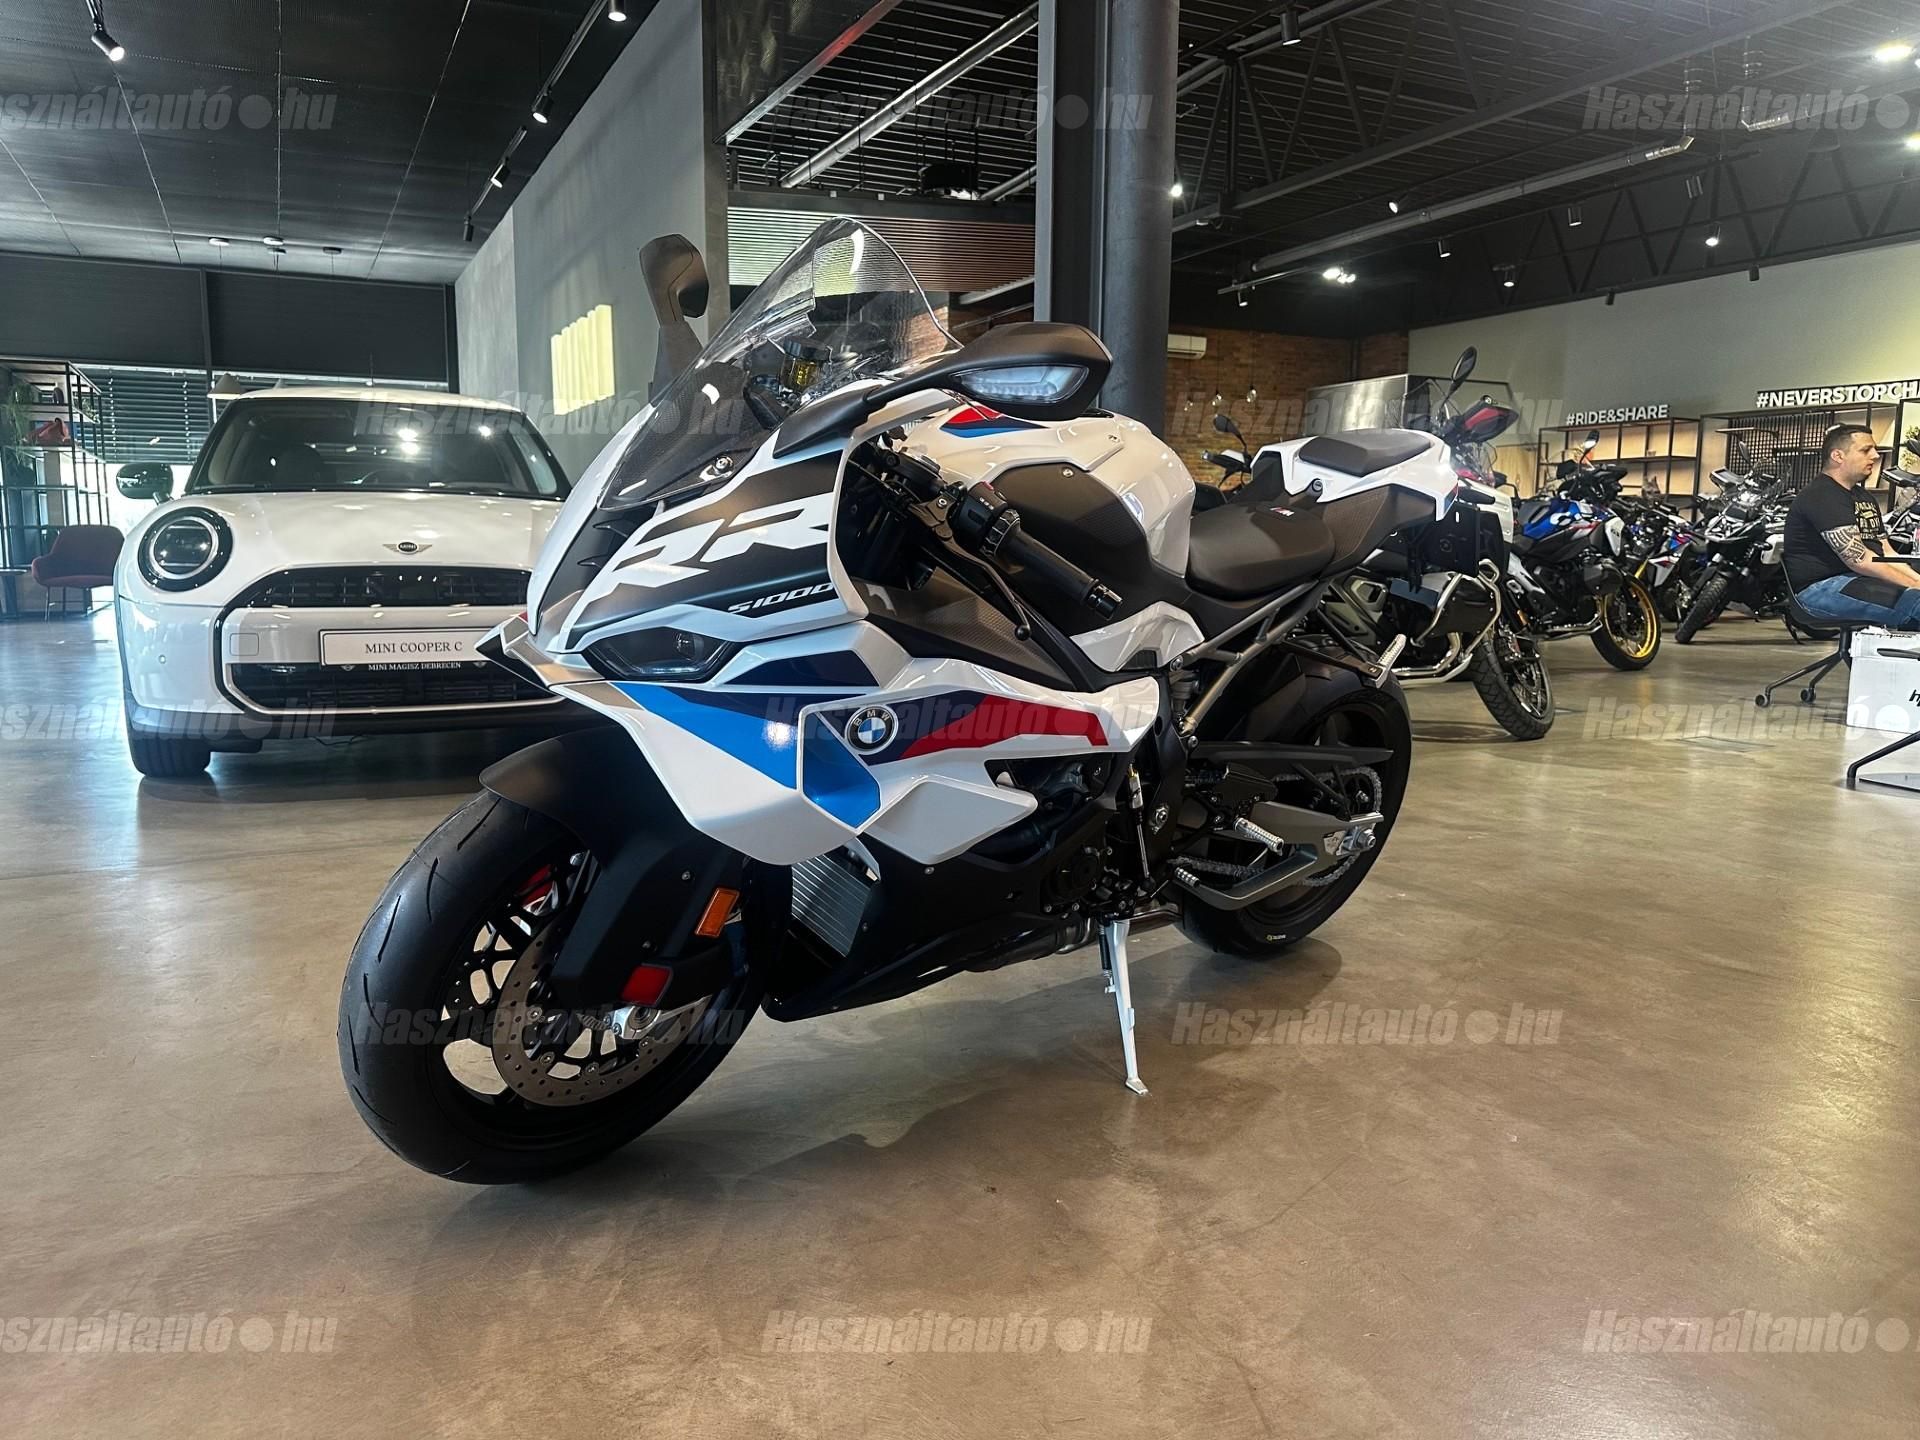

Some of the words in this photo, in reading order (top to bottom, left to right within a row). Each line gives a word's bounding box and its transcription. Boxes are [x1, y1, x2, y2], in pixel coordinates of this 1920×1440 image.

[1756, 379, 1920, 408] #NEVERSTOPCH
[1566, 404, 1668, 426] #RIDE&SHARE
[728, 582, 834, 614] S1000
[365, 642, 396, 654] MINI
[400, 641, 451, 653] COOPER
[454, 641, 463, 652] C
[368, 663, 387, 671] MINI
[421, 661, 461, 670] DEBRECEN
[853, 709, 890, 727] BMW
